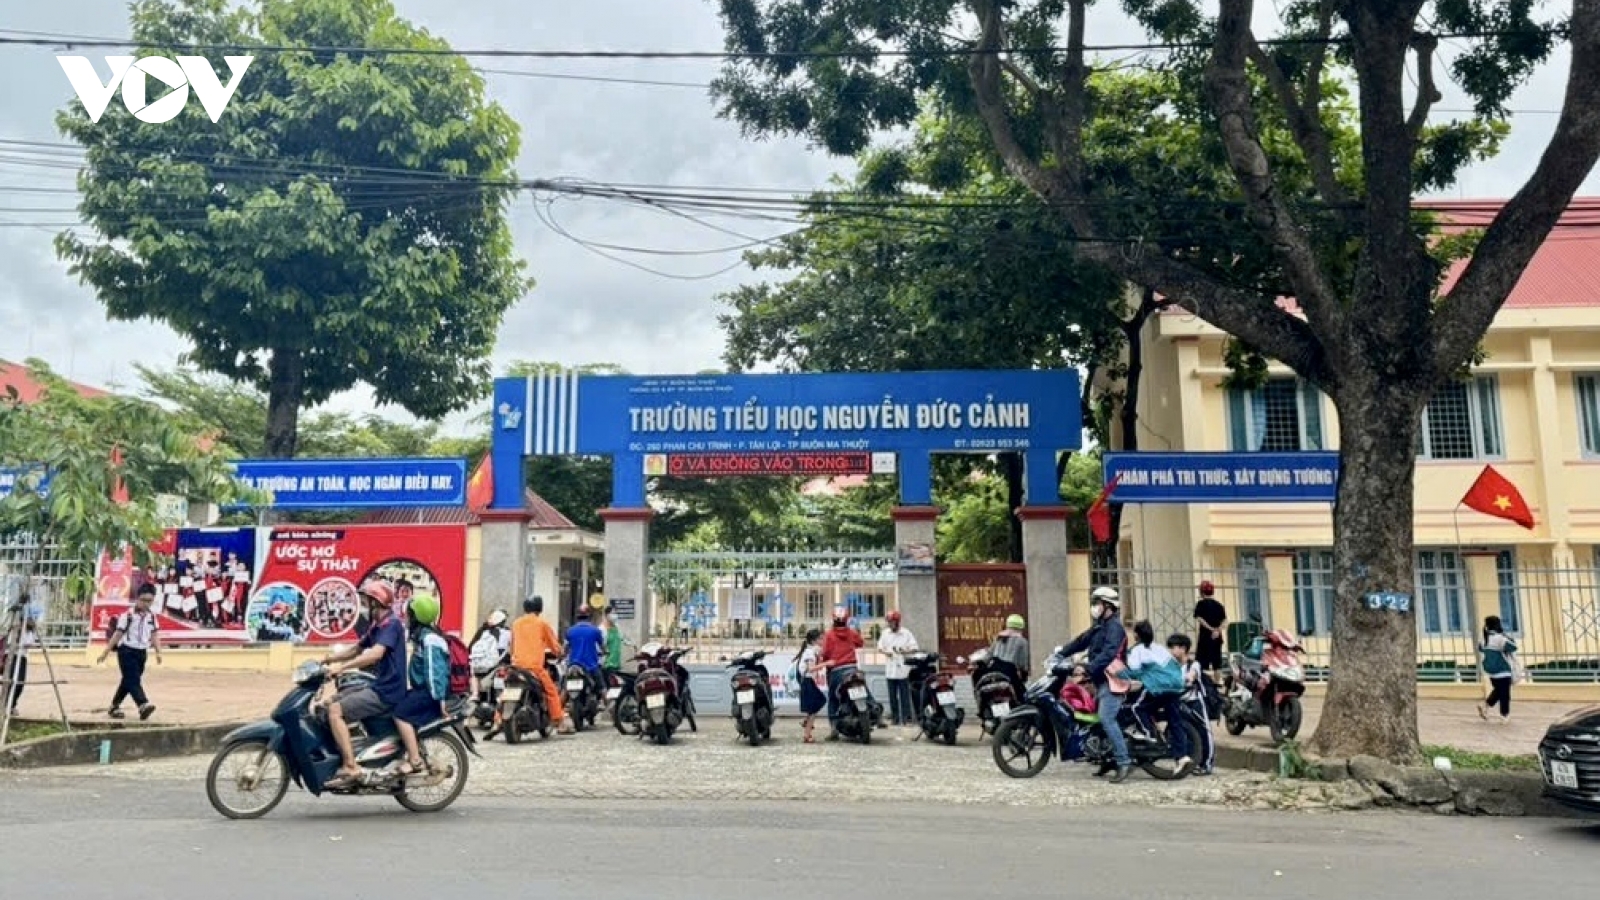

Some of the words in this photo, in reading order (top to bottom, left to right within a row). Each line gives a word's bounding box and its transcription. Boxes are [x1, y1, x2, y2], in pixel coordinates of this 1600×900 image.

[629, 401, 717, 432] TRƯỜNG
[722, 396, 769, 432] TIỂU
[775, 405, 817, 437] HỌC
[822, 395, 910, 430] NGUYỄN
[916, 397, 962, 429] ĐỨC
[968, 394, 1030, 429] CẢNH
[662, 441, 685, 451] PHAN
[749, 439, 765, 450] TÂN
[766, 440, 781, 451] LỢI
[787, 440, 799, 449] TP
[800, 439, 825, 449] BUÔN
[826, 440, 840, 449] MA
[842, 438, 870, 450] THUỘT
[710, 455, 760, 469] KHÔNG
[762, 455, 793, 469] VÀO
[797, 456, 846, 469] TRONG
[256, 475, 298, 491] TRƯỜNG
[300, 476, 315, 491] AN
[349, 475, 371, 493] HỌC
[374, 473, 403, 490] NGÀN
[405, 471, 430, 490] ĐIỀU
[1115, 468, 1148, 486] KHÁM
[1151, 468, 1175, 485] PHÁ
[1176, 470, 1196, 485] TRI
[1234, 467, 1256, 485] XÂY
[1258, 468, 1291, 487] DỰNG
[276, 543, 308, 558] ƯỚC
[311, 544, 336, 557] MƠ
[297, 557, 318, 574] SỰ
[320, 555, 359, 573] THẬT
[948, 581, 978, 606] TRƯỜNG
[979, 577, 996, 606] TIỂU
[997, 585, 1013, 610] HỌC
